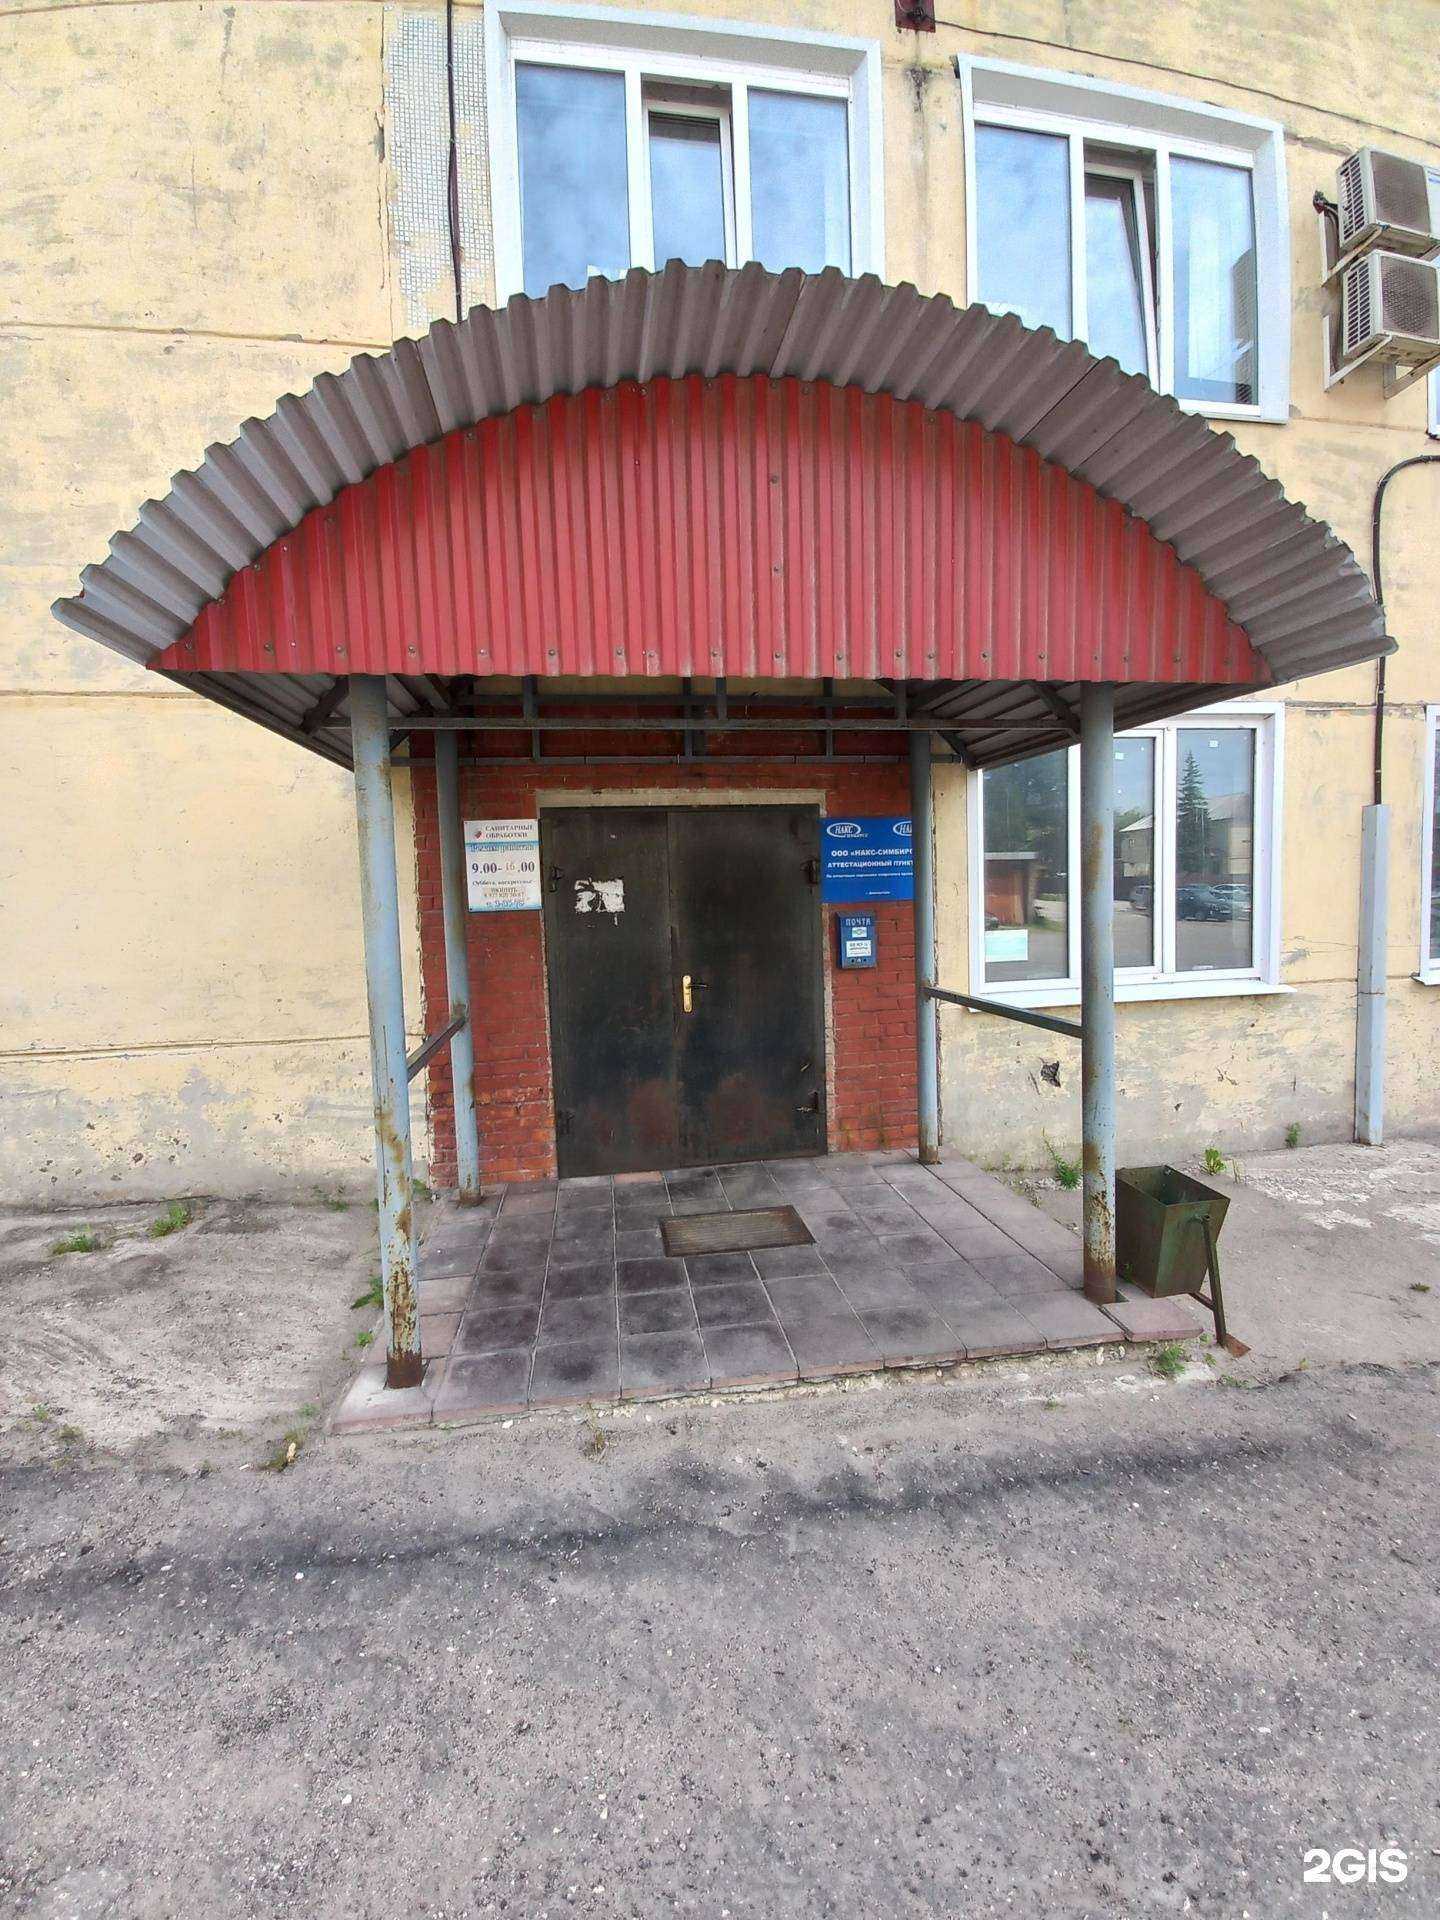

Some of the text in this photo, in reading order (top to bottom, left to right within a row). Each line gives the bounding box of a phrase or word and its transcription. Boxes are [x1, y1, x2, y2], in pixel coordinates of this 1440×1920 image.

[485, 824, 534, 832] САНИТАРНЫЕ
[834, 825, 854, 834] НАКС
[485, 831, 528, 839] ОБРАБОТКИ
[827, 860, 892, 868] АТТЕСТАЦИОННЫЙ
[845, 918, 871, 926] ПОЧТА
